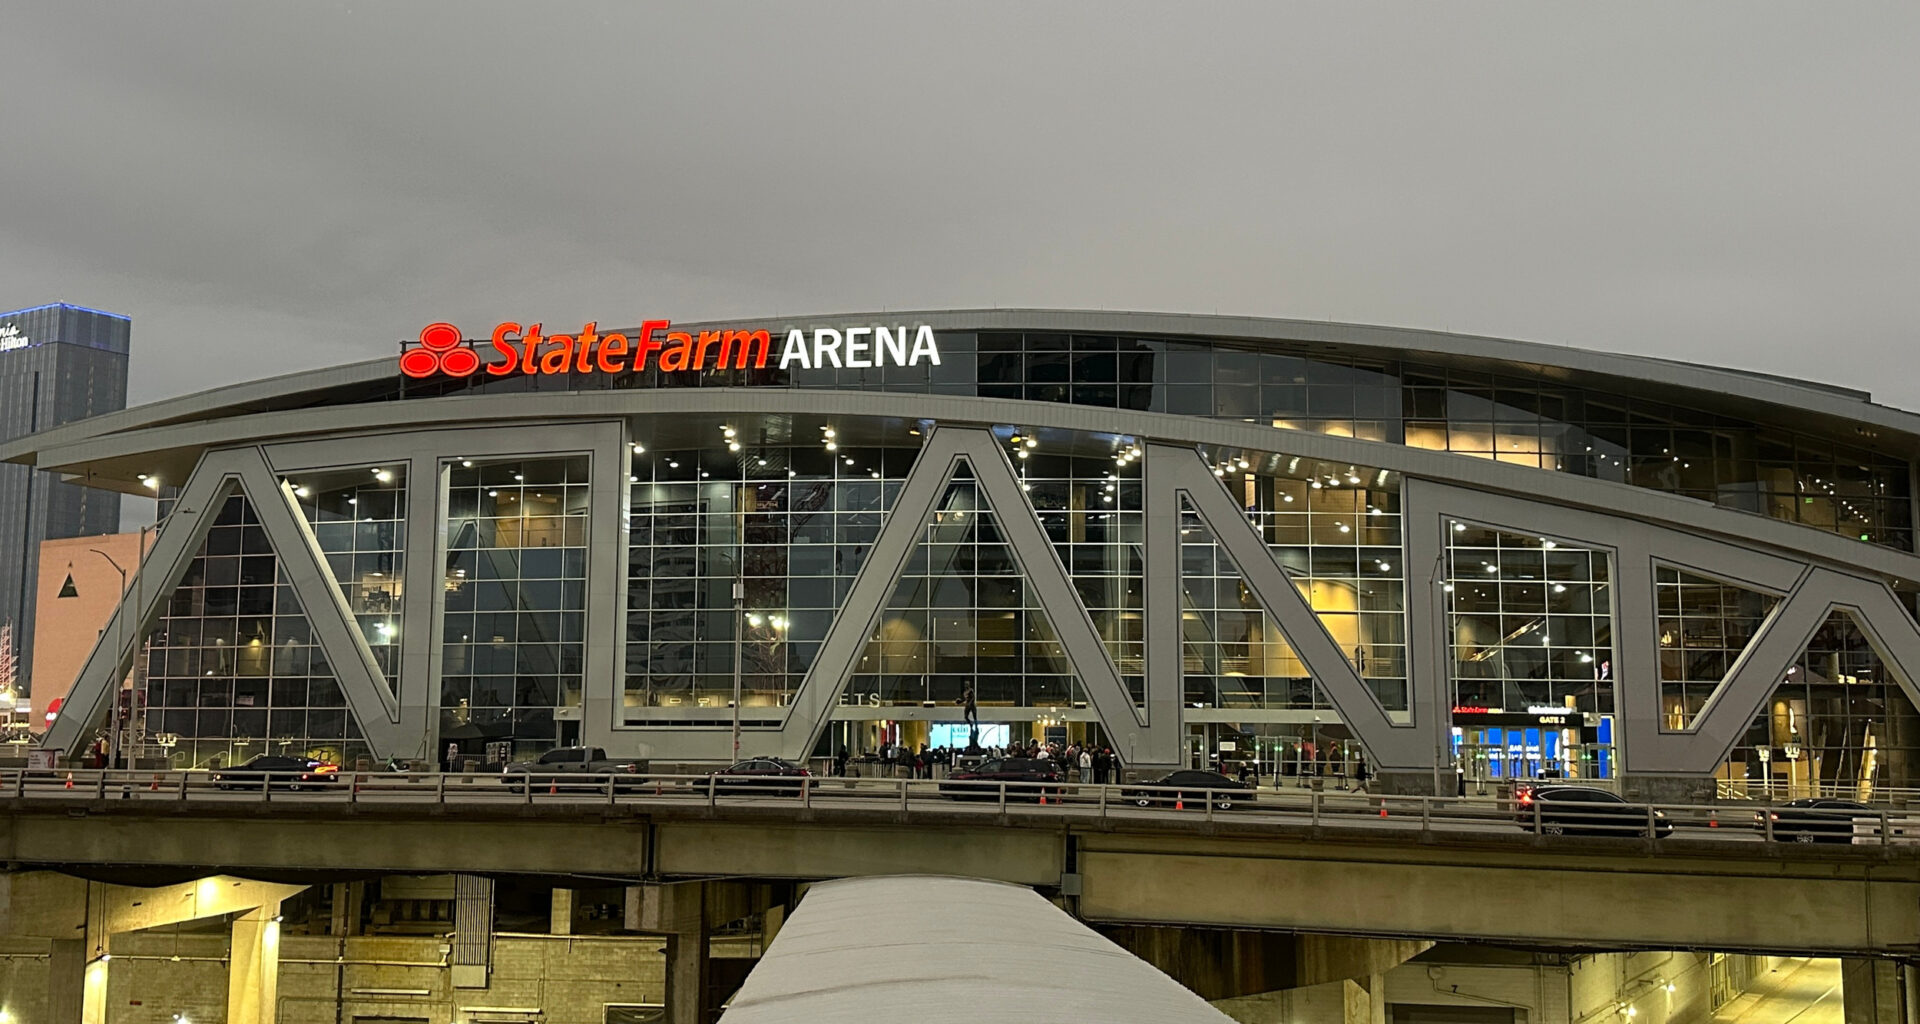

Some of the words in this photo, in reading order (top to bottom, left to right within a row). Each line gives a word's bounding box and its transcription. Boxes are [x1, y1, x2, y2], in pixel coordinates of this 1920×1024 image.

[1, 336, 29, 351] Hilton
[486, 321, 628, 376] State
[632, 319, 771, 373] Farm
[778, 325, 942, 370] ARENA
[1539, 716, 1559, 724] GATE
[1560, 716, 1566, 724] 2
